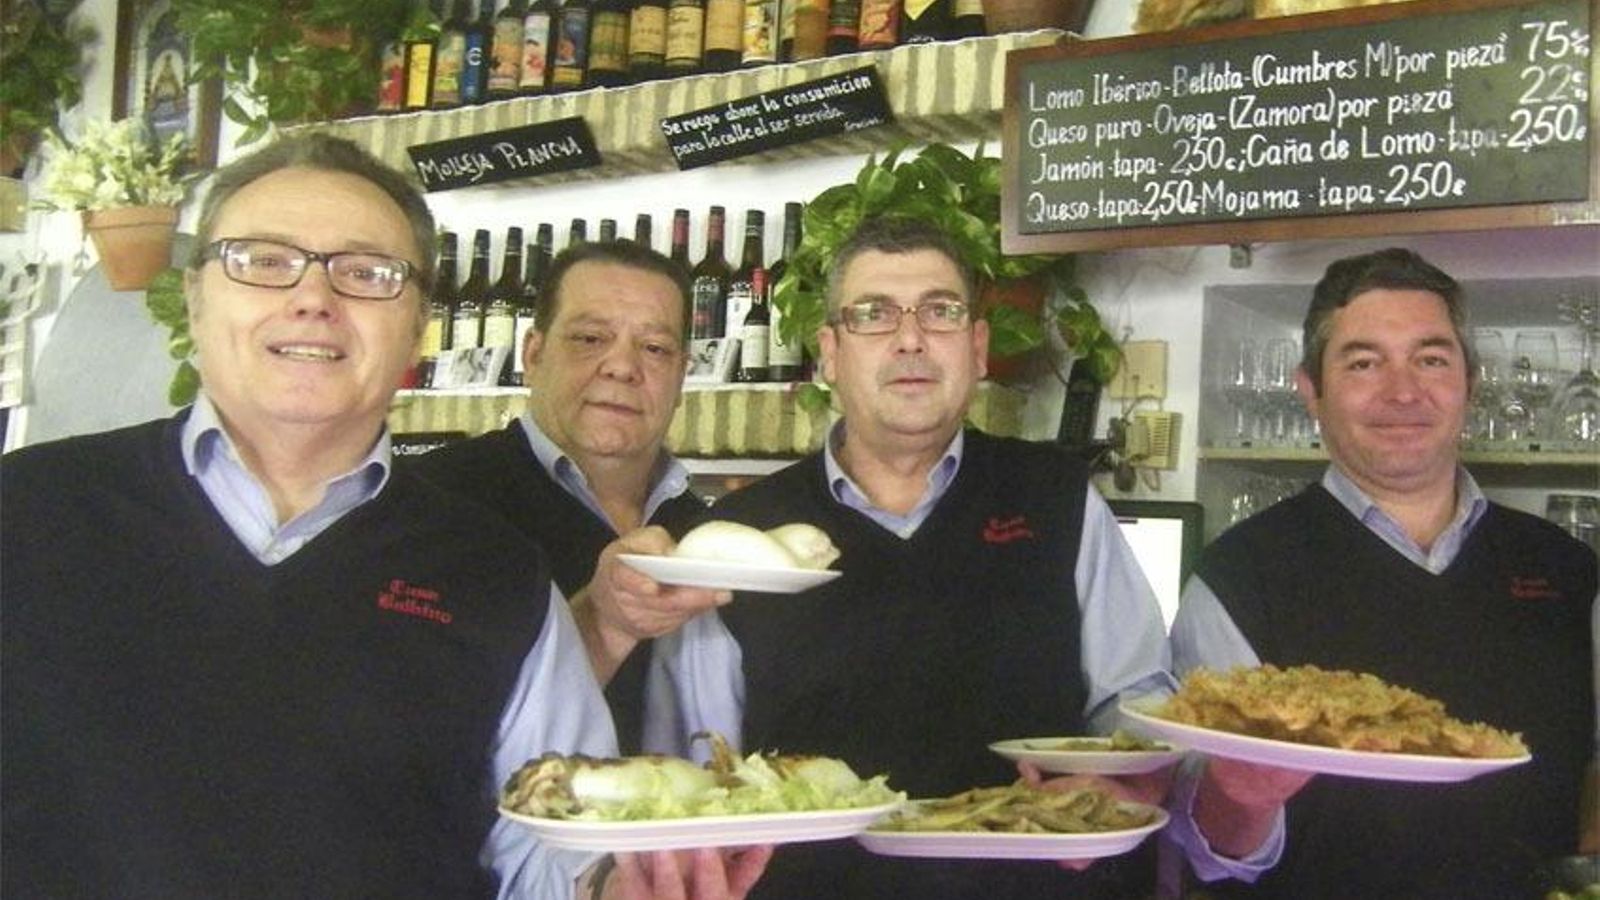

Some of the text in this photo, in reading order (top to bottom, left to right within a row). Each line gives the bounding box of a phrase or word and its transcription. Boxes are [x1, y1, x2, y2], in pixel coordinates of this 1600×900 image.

[1029, 81, 1084, 112] Lomo
[1028, 117, 1088, 148] Queso
[1319, 128, 1350, 160] de
[1027, 191, 1090, 224] Queso
[1201, 179, 1300, 216] Mojama
